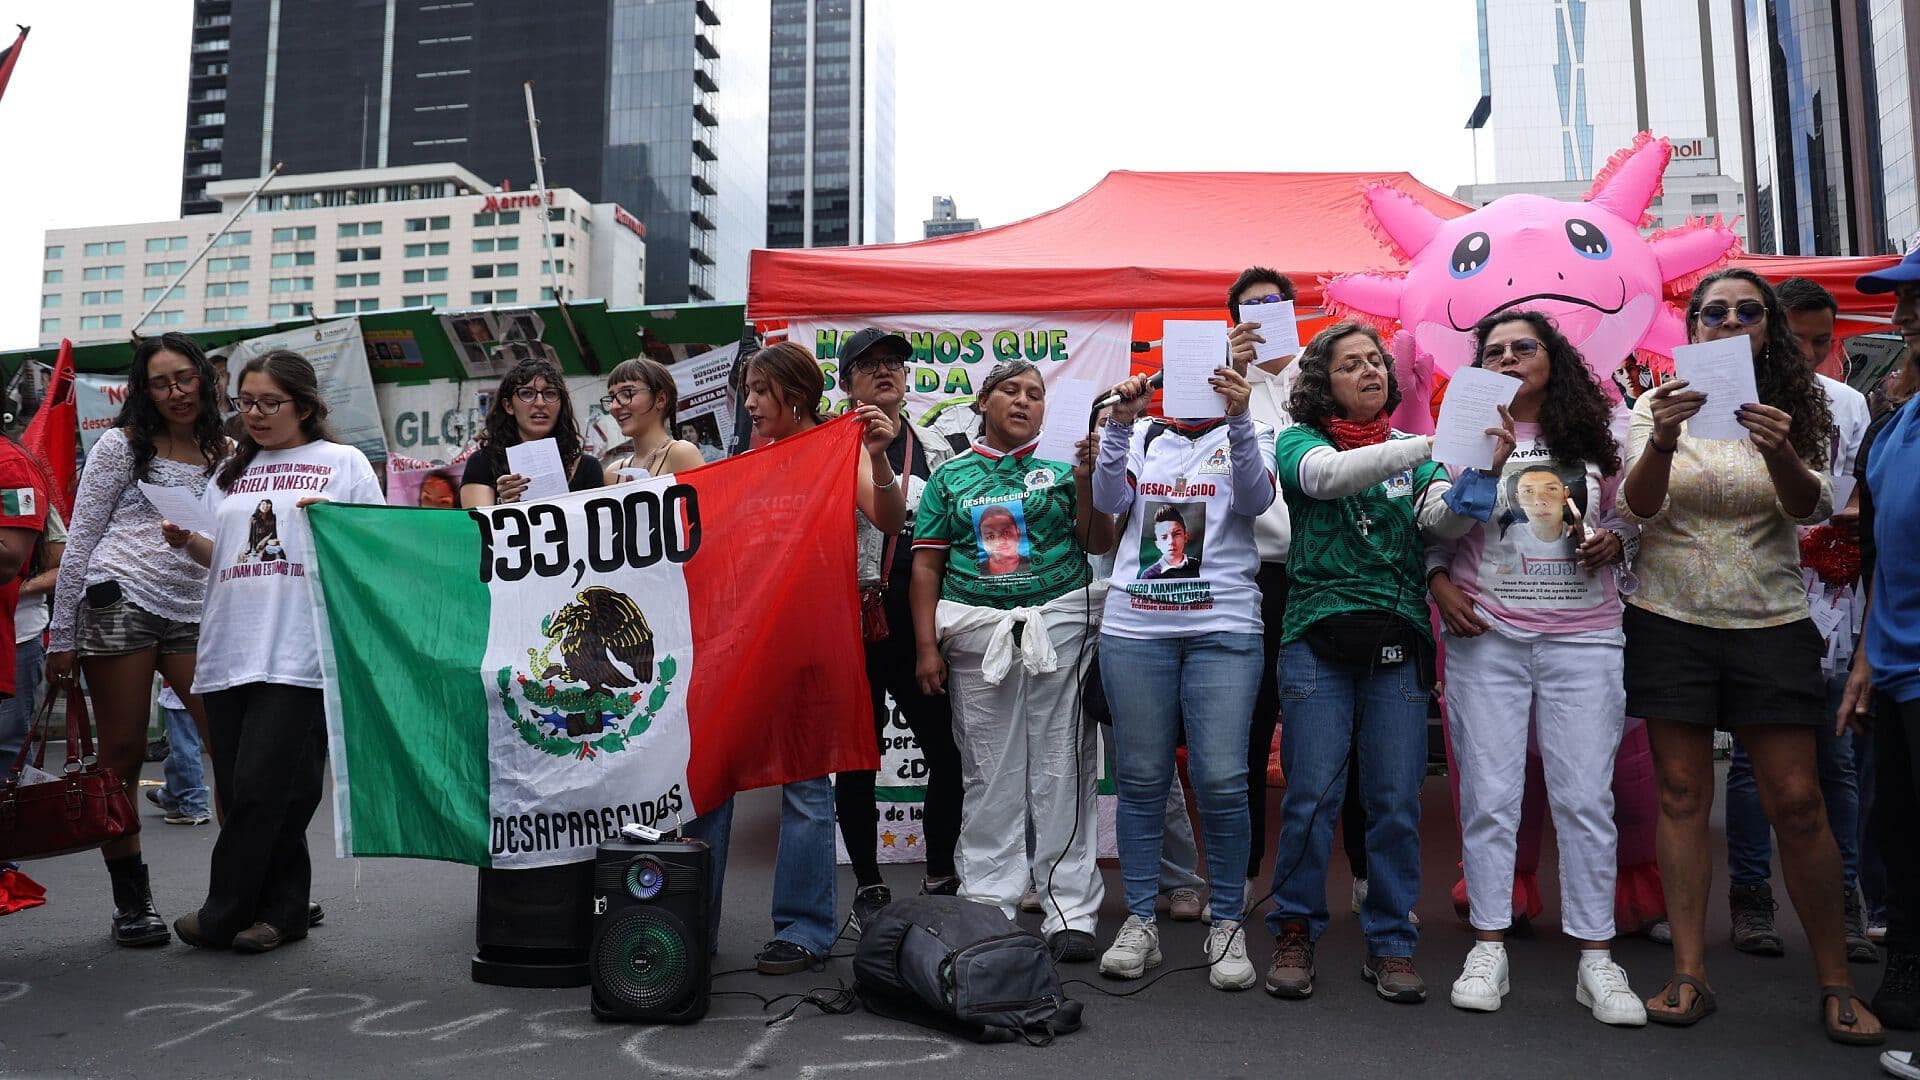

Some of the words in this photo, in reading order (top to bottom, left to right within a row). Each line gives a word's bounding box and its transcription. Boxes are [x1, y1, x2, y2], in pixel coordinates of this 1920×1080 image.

[481, 191, 554, 213] Marriot
[816, 329, 985, 364] HAMOS
[992, 329, 1070, 363] QUE
[469, 483, 702, 588] 133,000
[1126, 583, 1149, 594] DIEGO
[1151, 581, 1211, 594] MAXIMILIANO
[491, 783, 683, 855] DESAPARECIDOS
[885, 805, 904, 821] de
